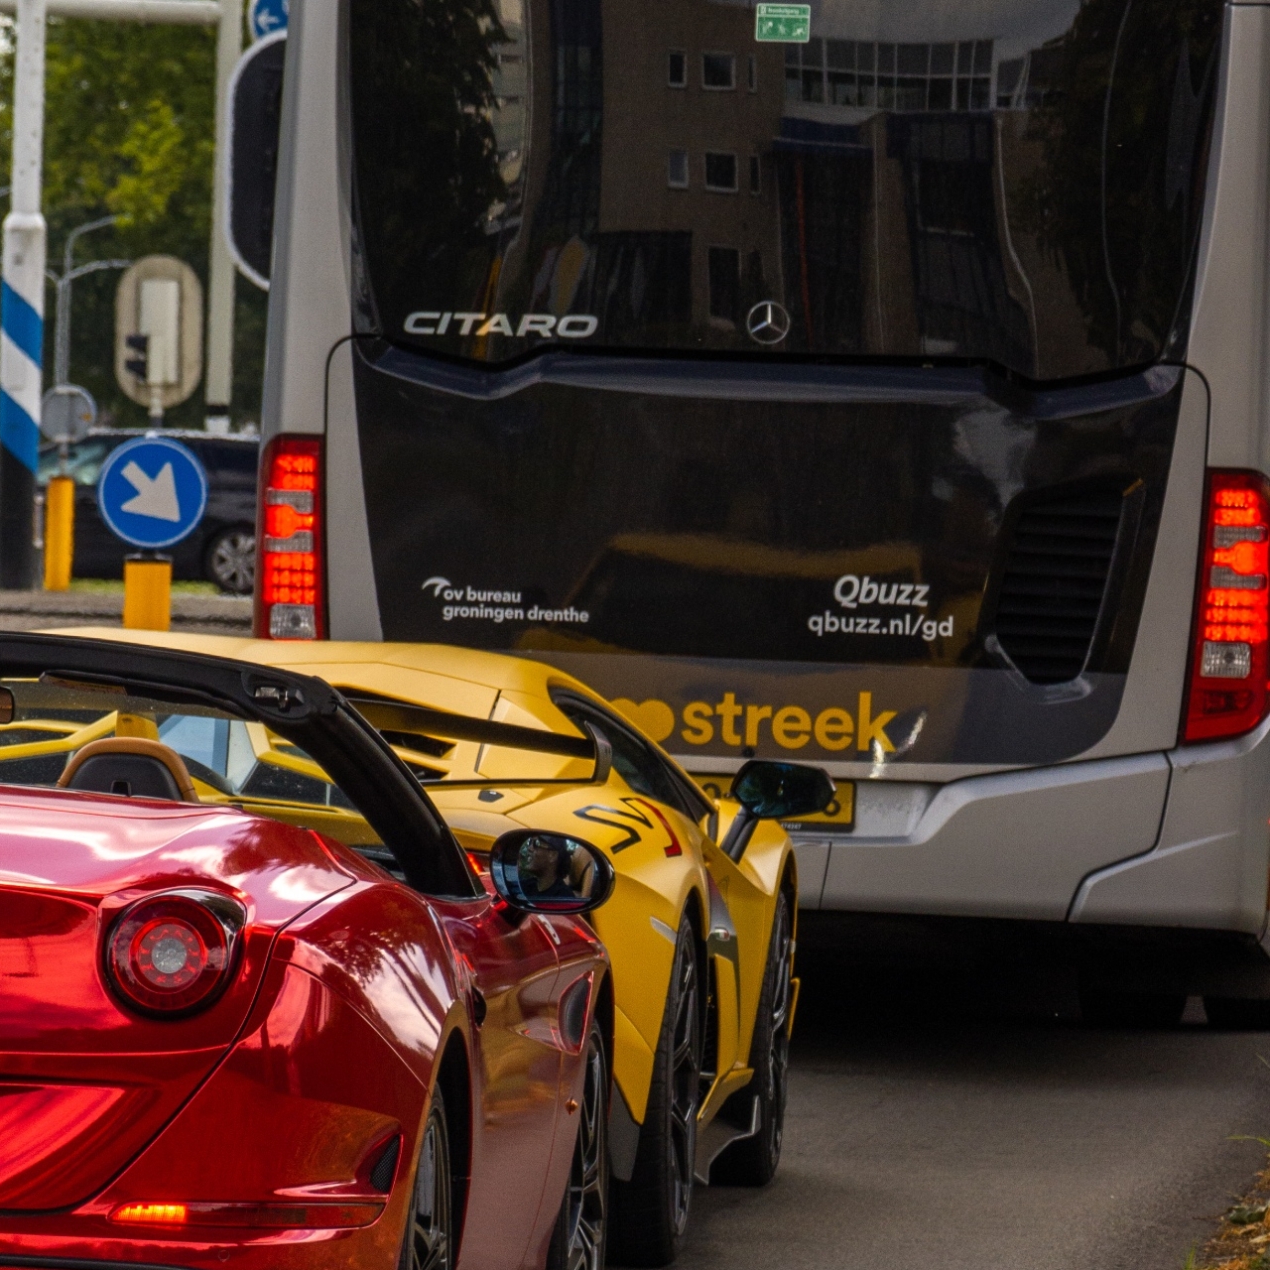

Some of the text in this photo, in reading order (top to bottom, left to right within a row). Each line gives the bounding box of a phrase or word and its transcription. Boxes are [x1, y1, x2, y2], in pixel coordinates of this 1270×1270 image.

[403, 311, 599, 338] CITARO
[443, 585, 522, 603] ov bureau
[833, 574, 930, 609] Qbuzz
[442, 604, 589, 623] groningen drenthe
[807, 610, 954, 642] qbuzz.nl/gd
[681, 691, 897, 753] streek
